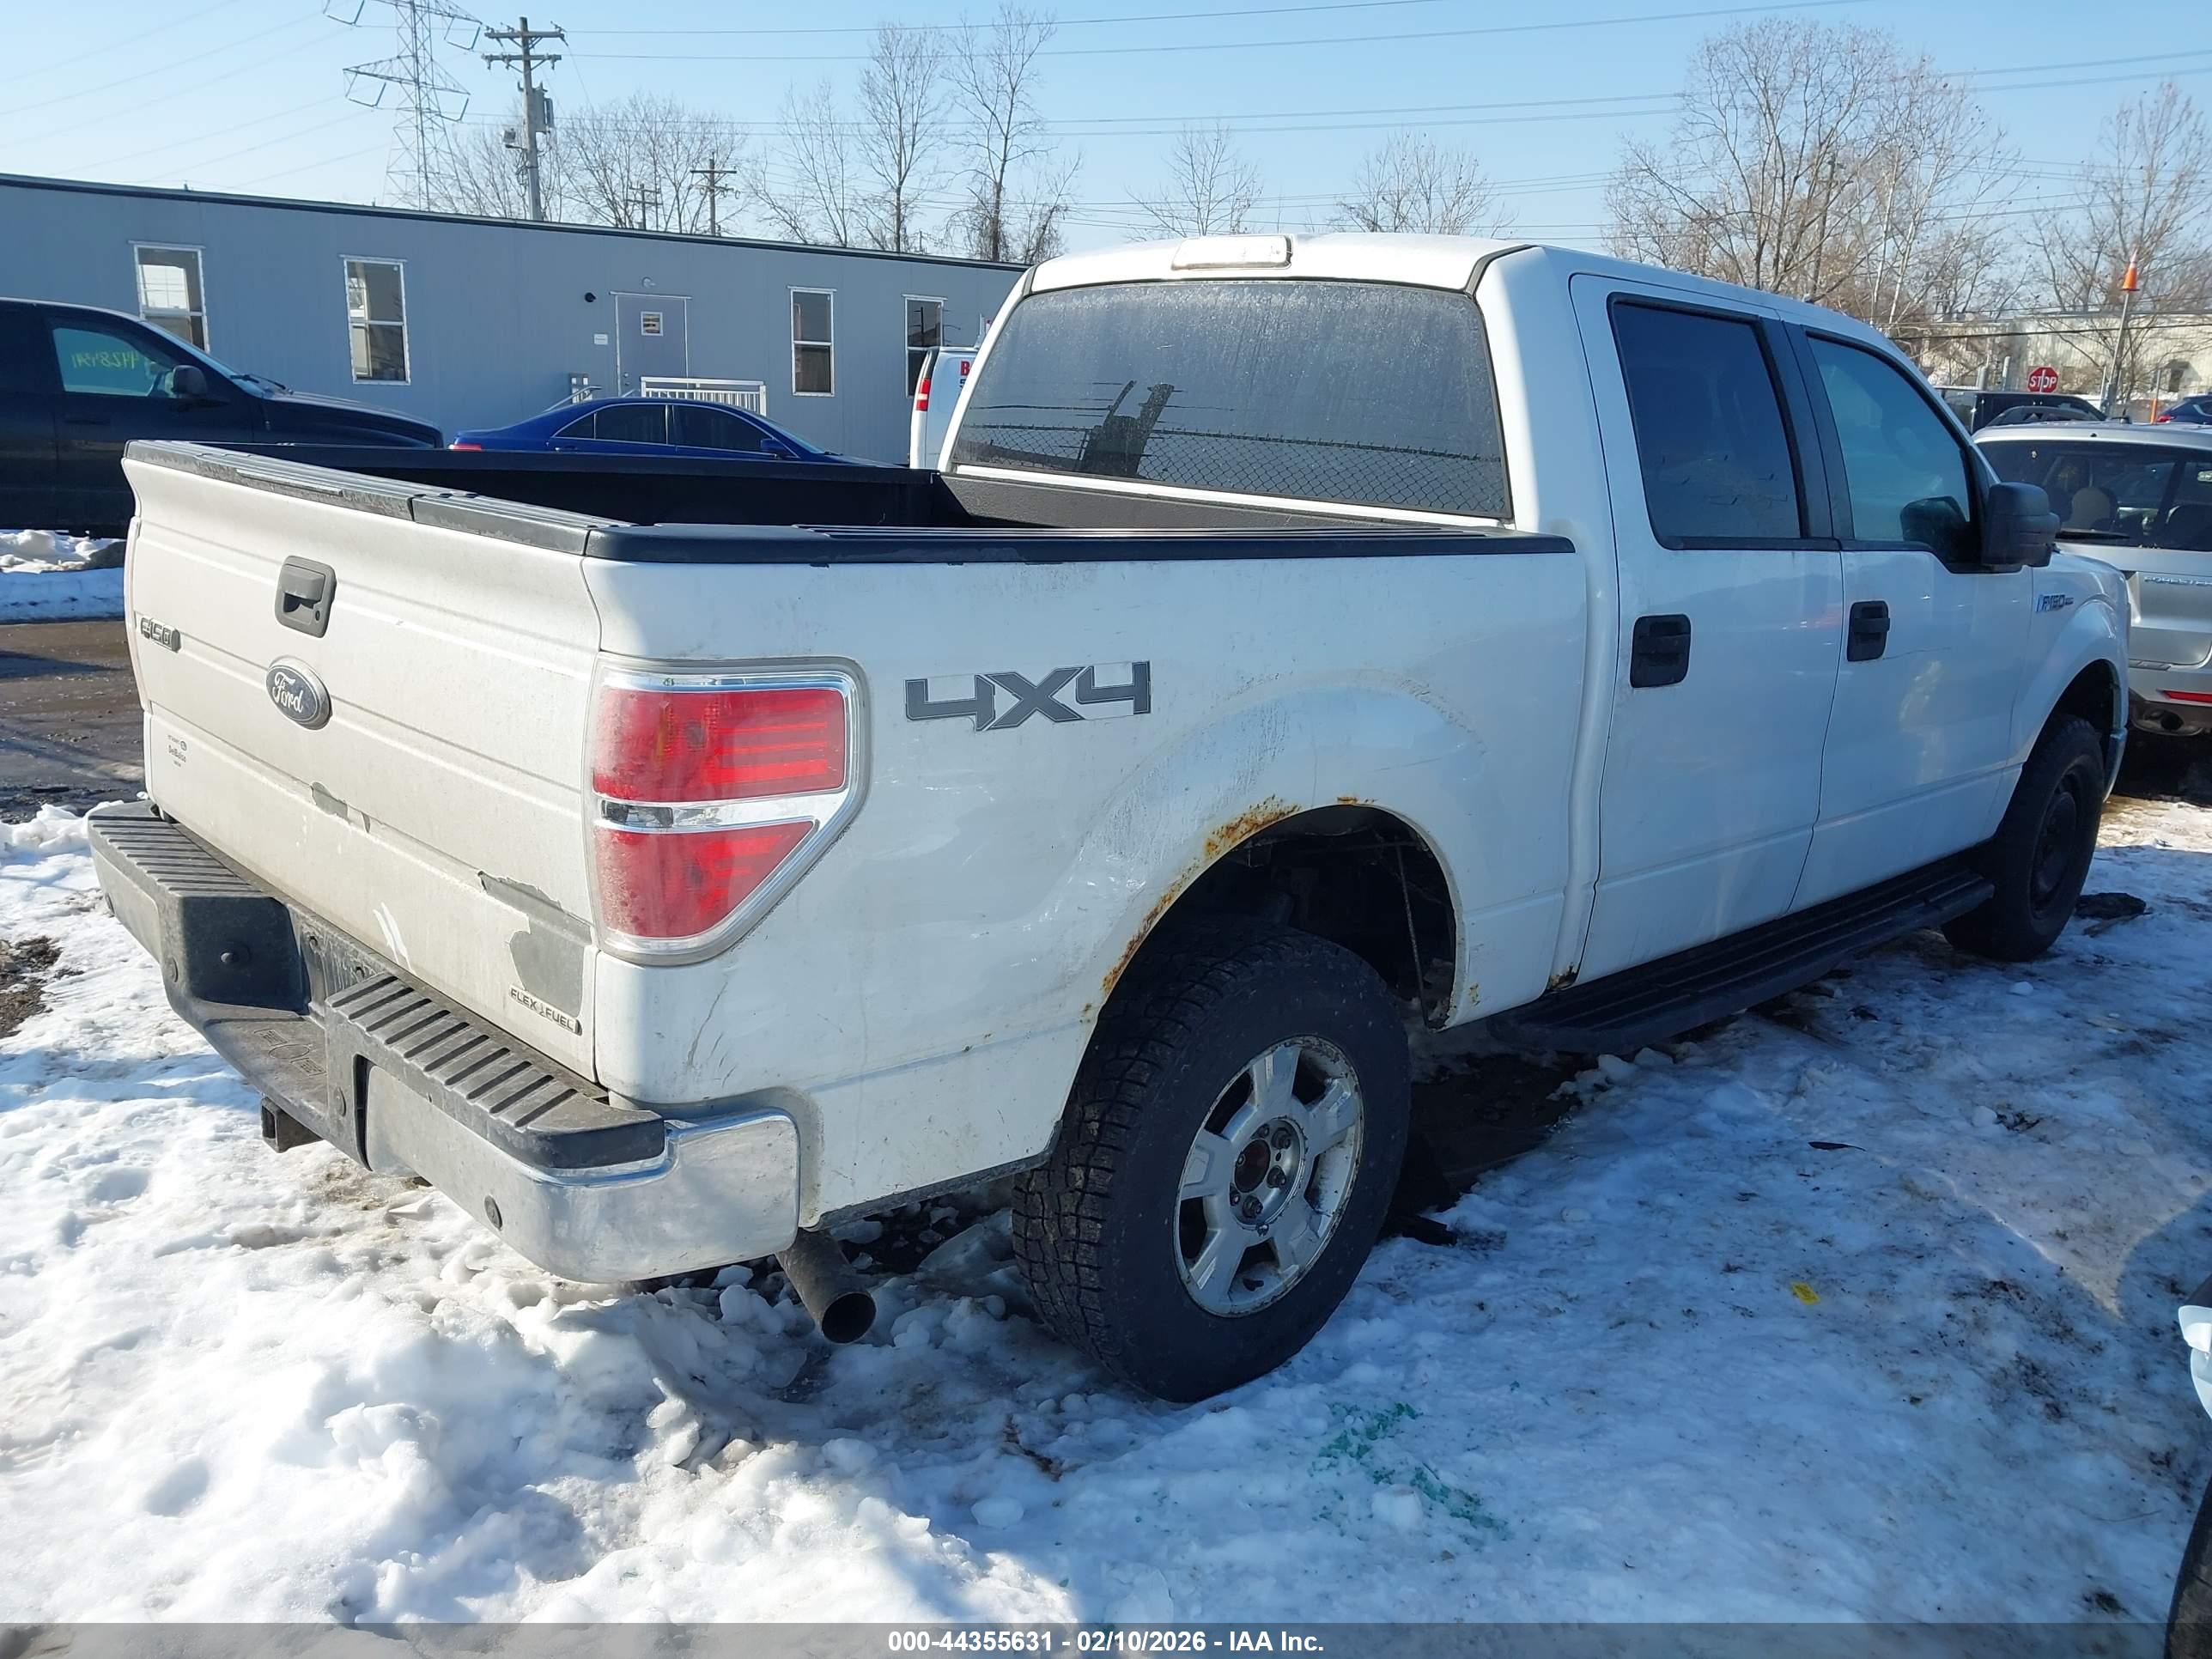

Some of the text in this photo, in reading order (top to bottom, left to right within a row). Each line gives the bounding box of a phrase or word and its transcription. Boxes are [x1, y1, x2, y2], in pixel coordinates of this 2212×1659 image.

[2029, 375, 2057, 389] STOP
[272, 671, 303, 714] Ford
[904, 660, 1148, 732] 4X4
[510, 988, 574, 1031] FLEX FUEL
